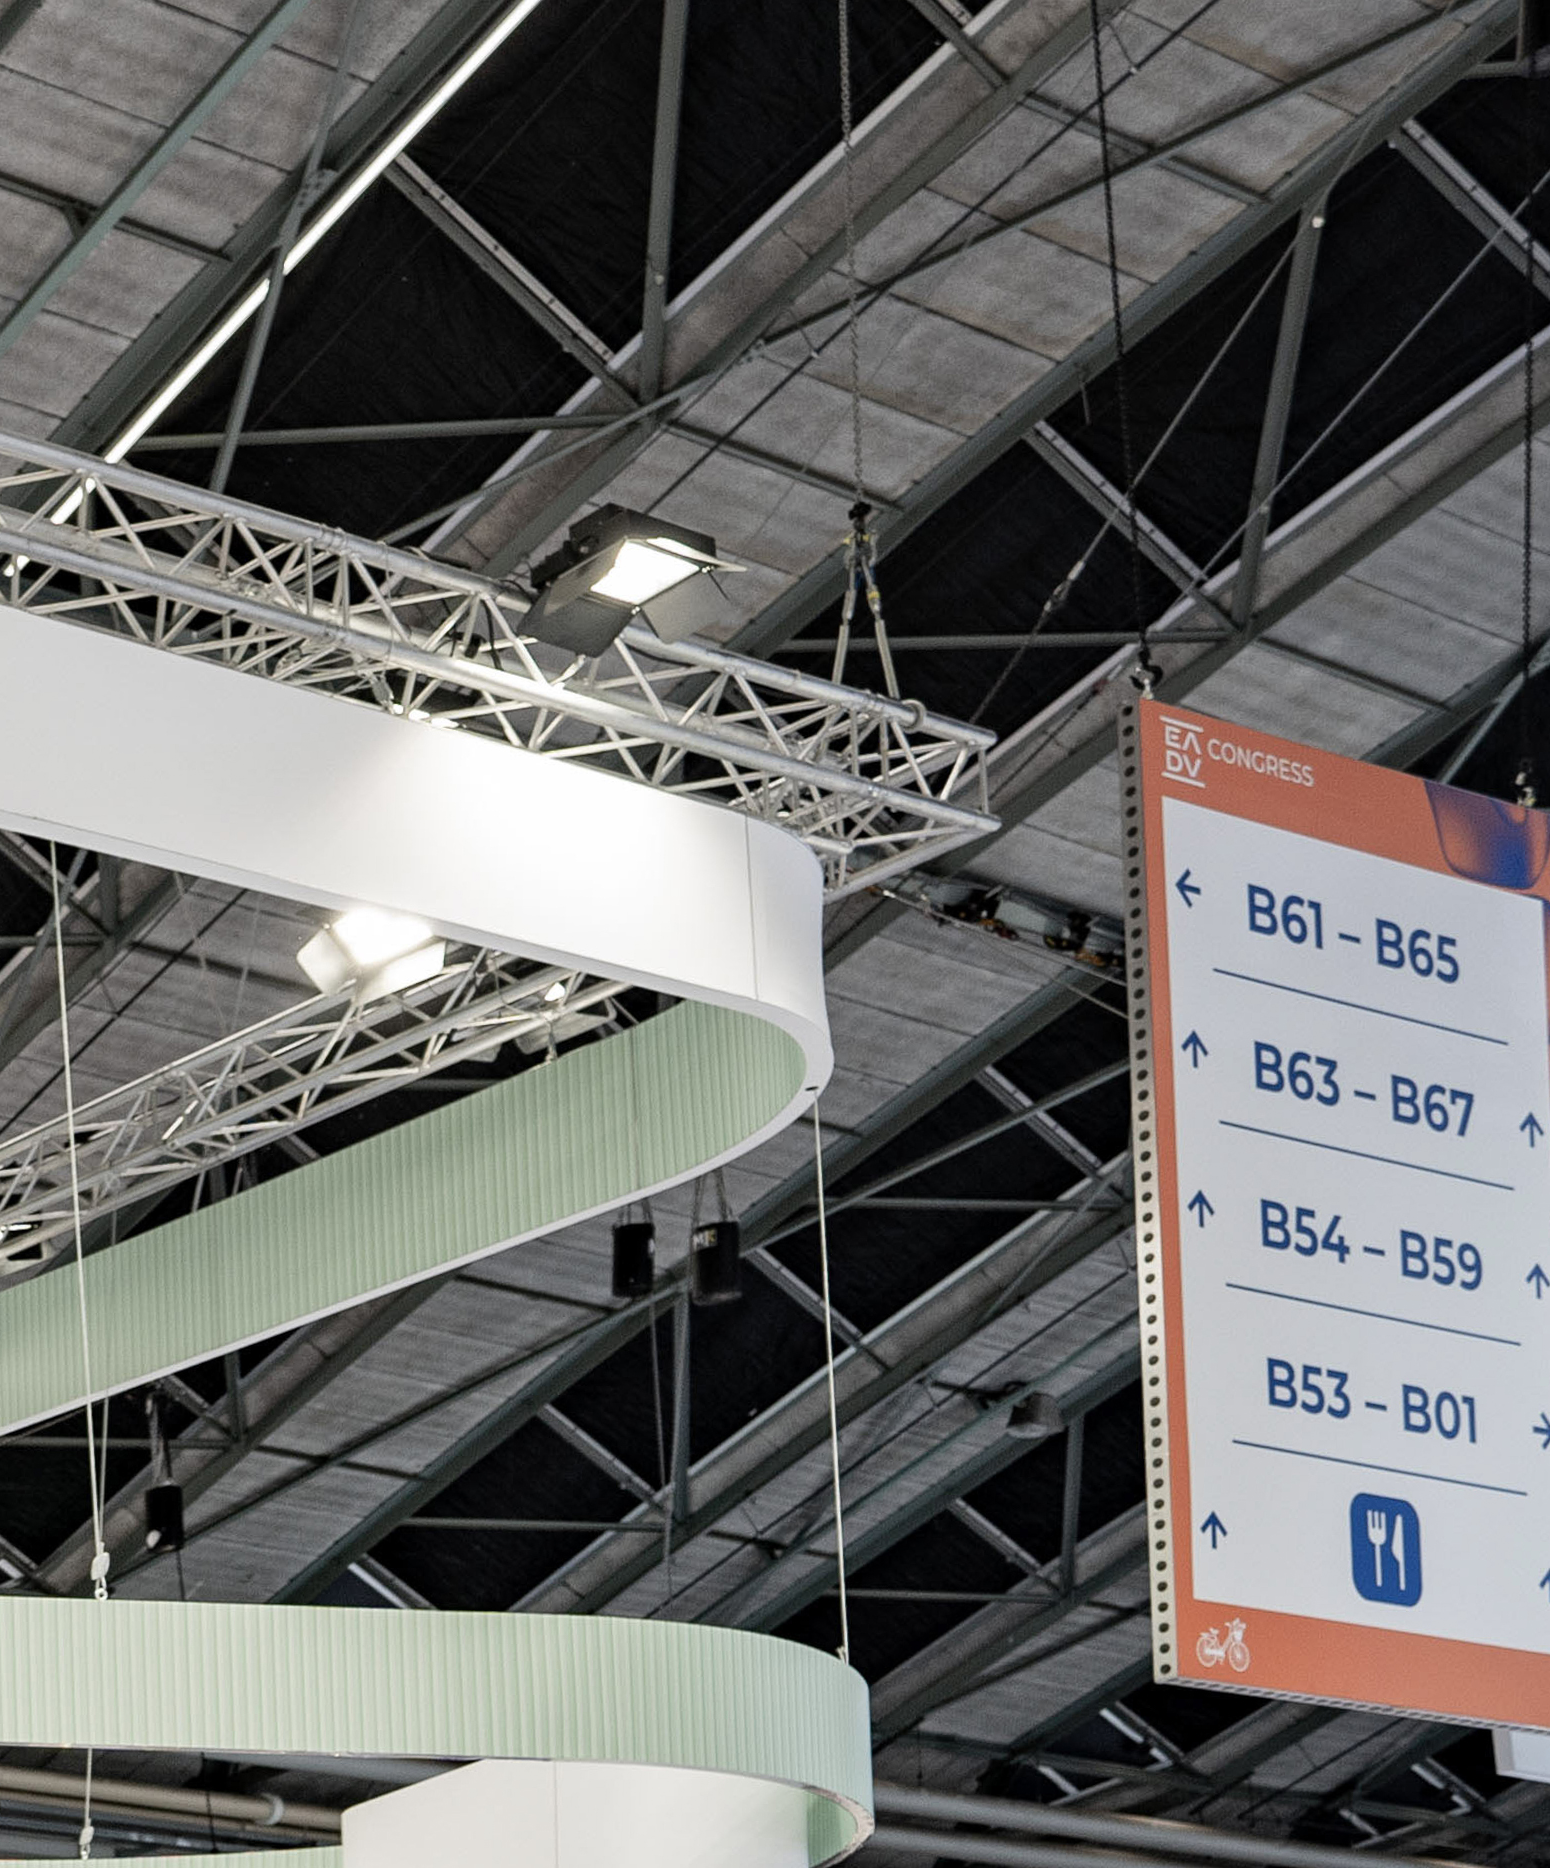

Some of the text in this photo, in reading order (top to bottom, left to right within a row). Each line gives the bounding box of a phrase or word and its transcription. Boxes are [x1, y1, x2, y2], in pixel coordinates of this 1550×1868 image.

[1165, 751, 1203, 779] DV
[1207, 738, 1314, 788] CONGRESS
[1247, 883, 1460, 985] B61 B65
[1252, 1040, 1475, 1139] B63 B67
[1259, 1196, 1484, 1292] B54 B59
[1265, 1356, 1479, 1444] B53 B01
